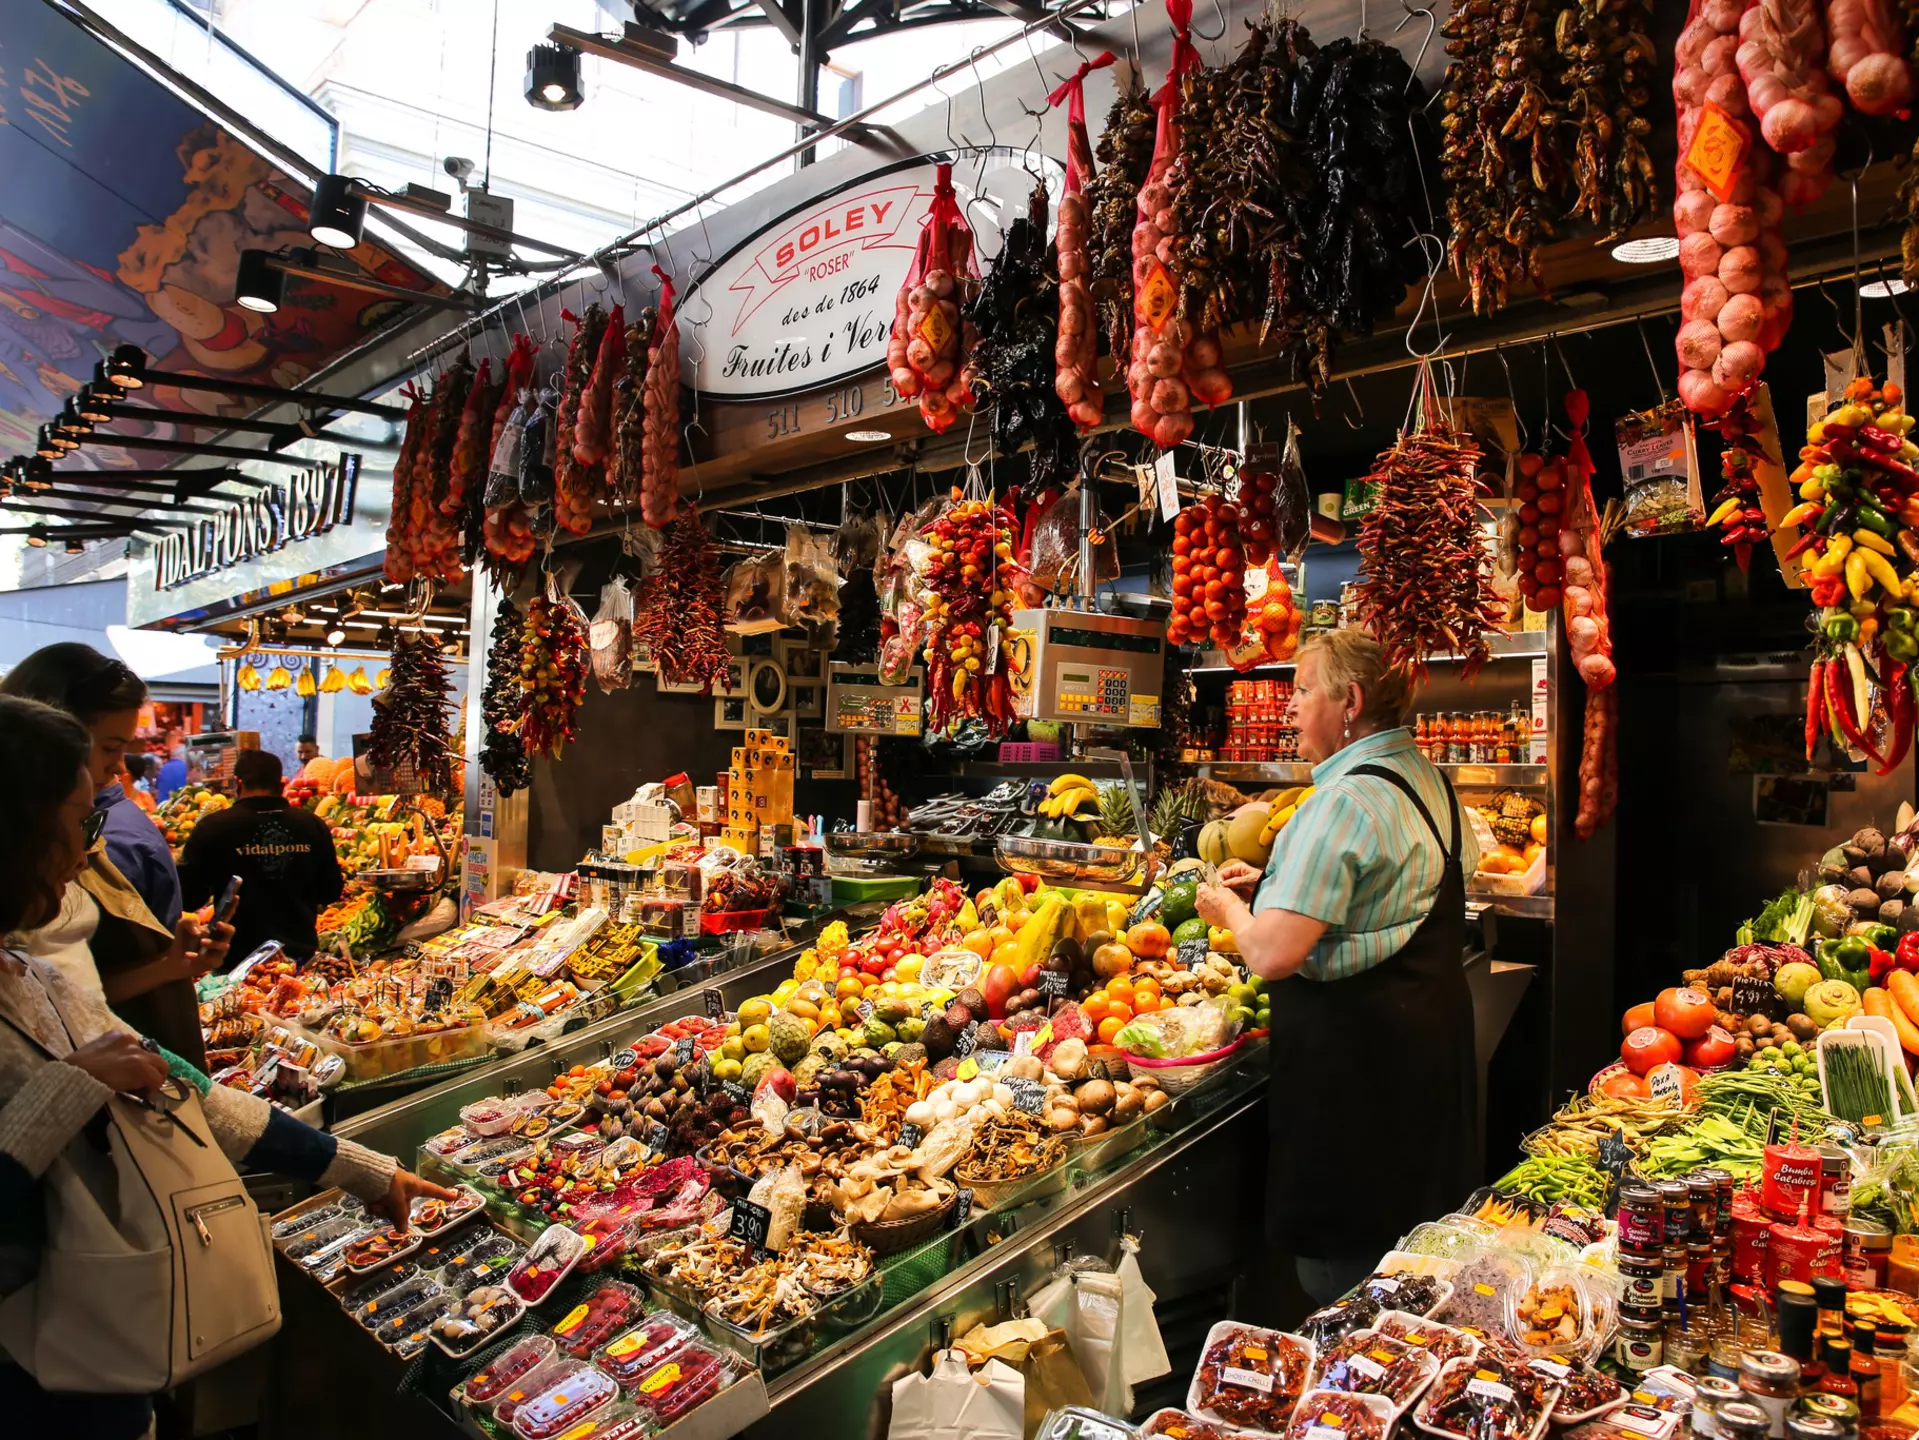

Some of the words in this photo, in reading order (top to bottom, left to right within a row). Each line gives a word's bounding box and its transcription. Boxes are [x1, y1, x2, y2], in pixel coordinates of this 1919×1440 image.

[776, 201, 893, 268] SOLEY
[781, 308, 809, 326] des
[815, 295, 835, 313] de
[840, 274, 881, 305] 1864
[722, 343, 813, 378] Fruites
[821, 332, 834, 363] i
[768, 404, 800, 439] 511
[824, 385, 863, 424] 510
[1343, 502, 1371, 516] GREEN
[152, 519, 207, 592] VIDAL
[211, 484, 274, 568] PONS
[235, 843, 311, 856] vidalpons
[1780, 1164, 1814, 1176] Bumba
[732, 1214, 762, 1240] 3'90
[1627, 1227, 1651, 1236] Carolina
[1225, 1372, 1246, 1382] GHOST
[1247, 1376, 1270, 1388] CHILLI
[1470, 1382, 1484, 1391] MIX
[1486, 1384, 1509, 1396] CHILLI
